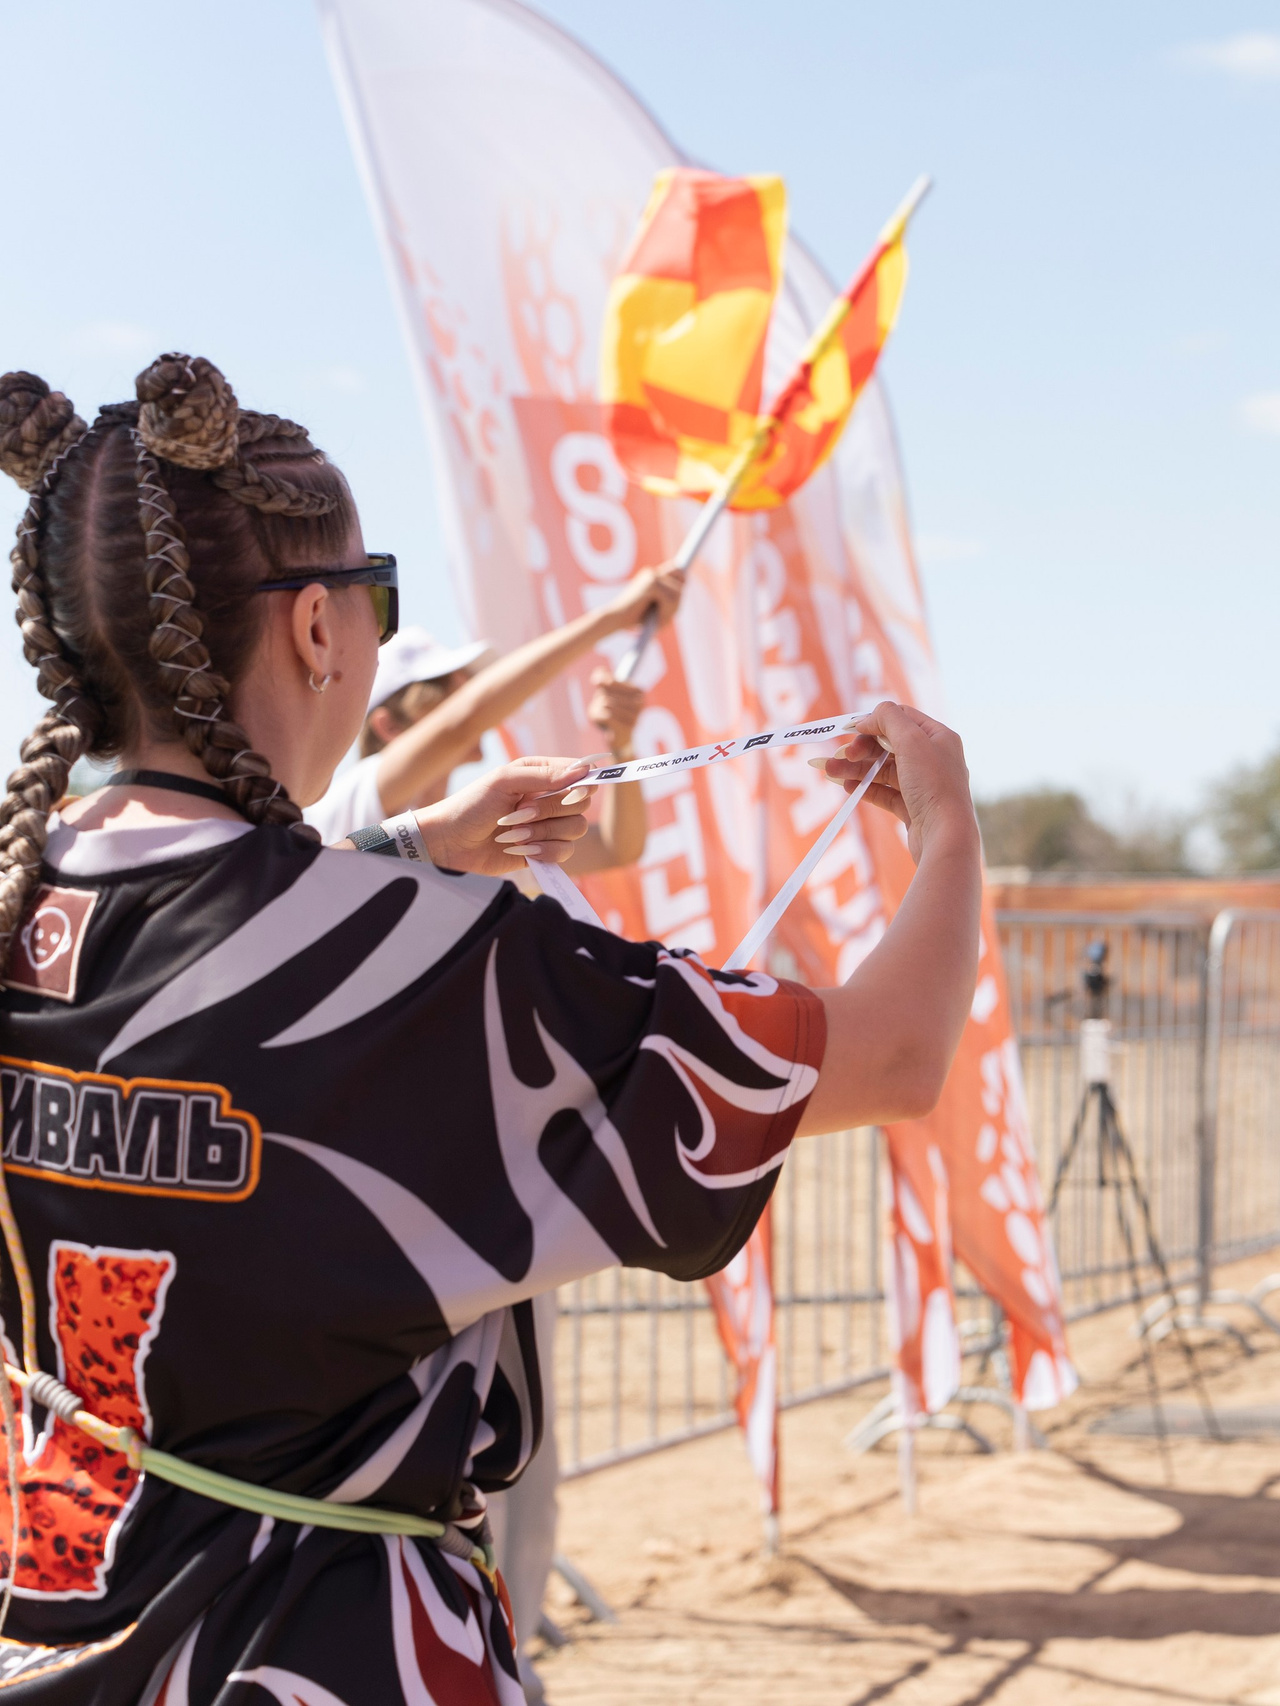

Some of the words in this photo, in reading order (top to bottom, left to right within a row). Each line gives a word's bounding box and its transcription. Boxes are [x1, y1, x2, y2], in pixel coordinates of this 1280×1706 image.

[783, 724, 836, 739] ULTRA100
[636, 760, 670, 772] ПЕСОК
[671, 757, 681, 766] 10
